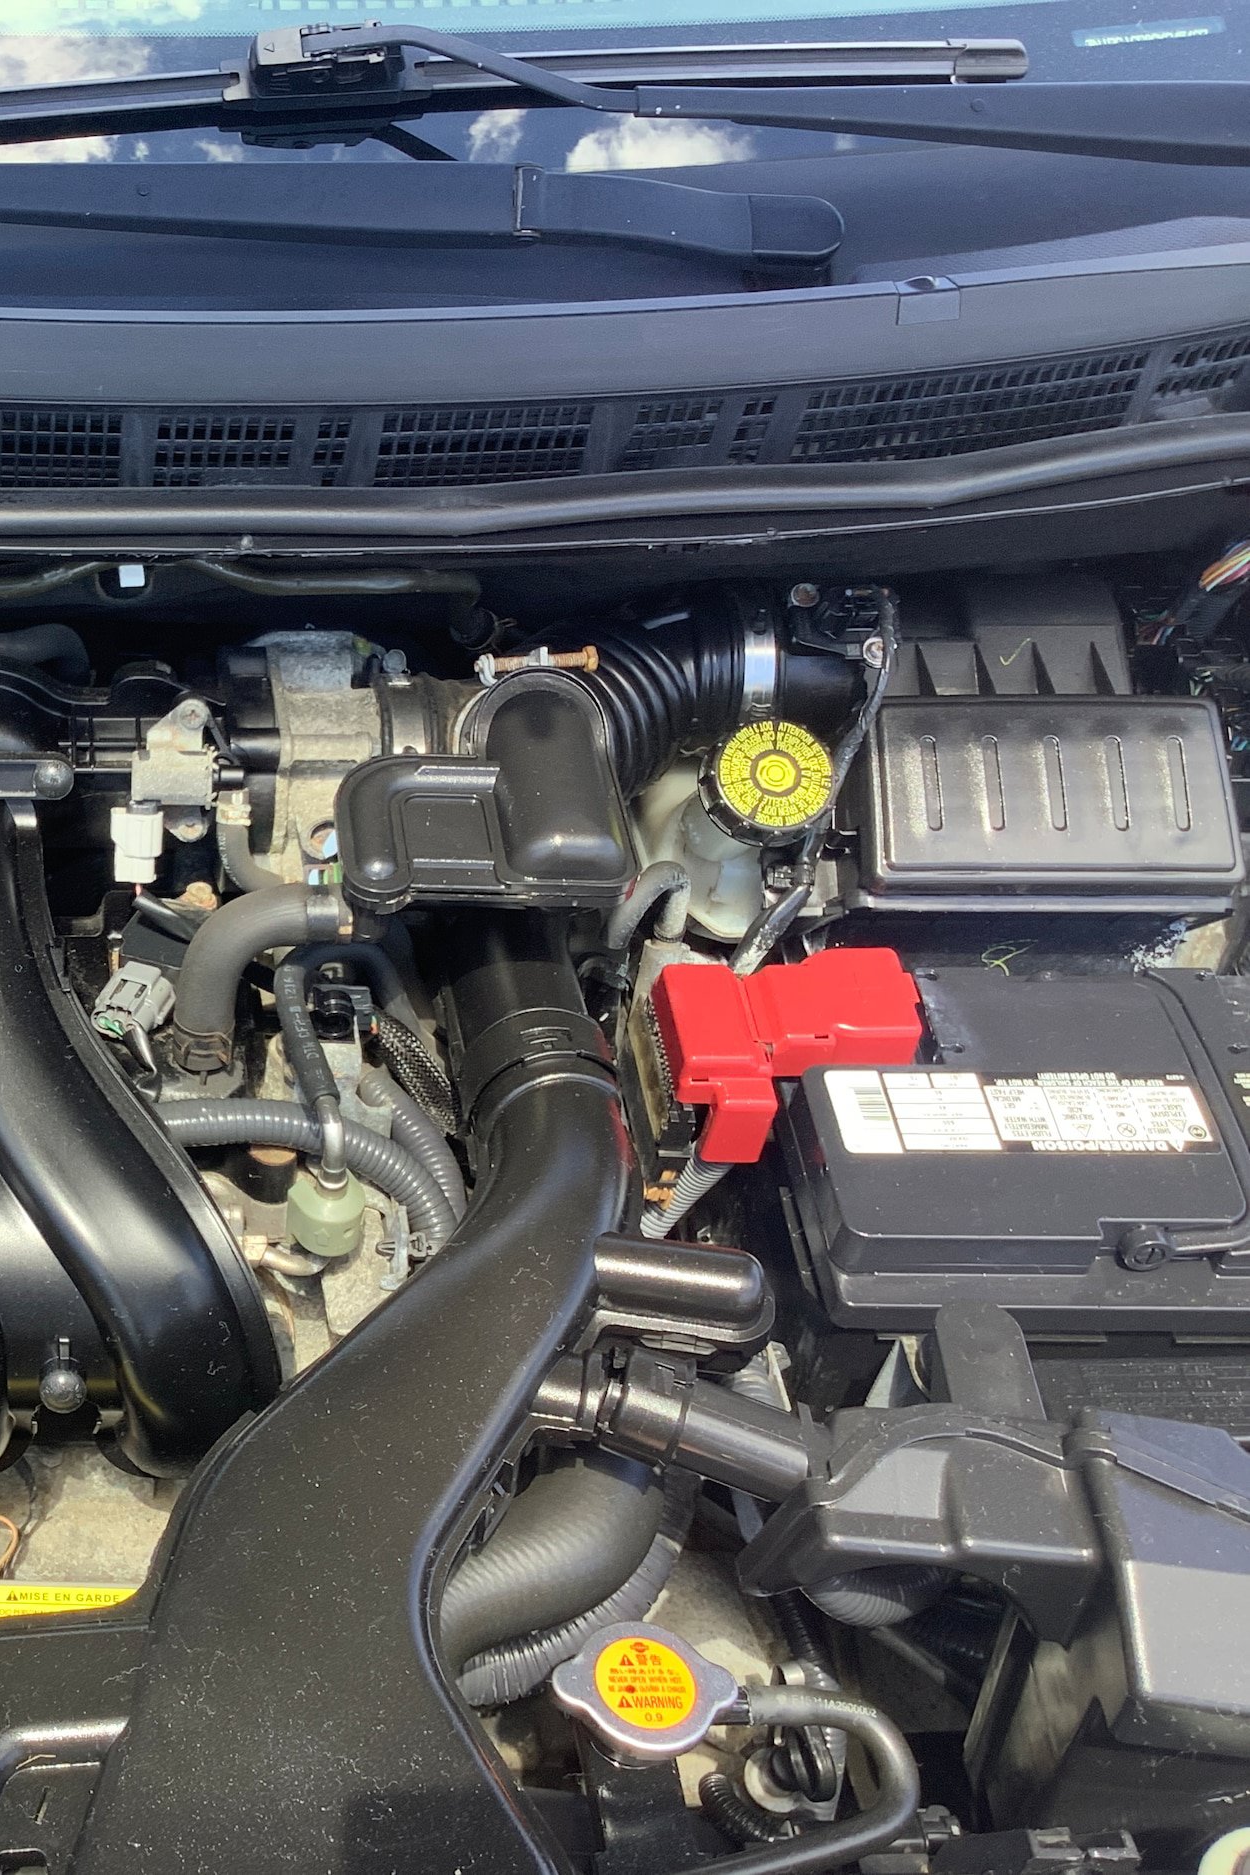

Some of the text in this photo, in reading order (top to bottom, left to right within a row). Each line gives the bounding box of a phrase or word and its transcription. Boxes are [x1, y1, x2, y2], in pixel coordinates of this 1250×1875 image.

[735, 725, 755, 743] FLUID
[757, 720, 773, 733] DOT
[778, 721, 816, 745] ATTENTION
[738, 733, 762, 754] BEFORE
[759, 731, 774, 742] CAP
[724, 737, 742, 757] FROM
[810, 740, 831, 776] NETTOYER
[719, 758, 732, 785] SEALED
[732, 781, 746, 797] USE
[784, 809, 808, 827] AVANT
[19, 1592, 49, 1601] MISE
[54, 1593, 71, 1602] EN
[76, 1593, 120, 1603] GARDE
[631, 1695, 684, 1710] WARNING
[644, 1712, 664, 1722] 0.9
